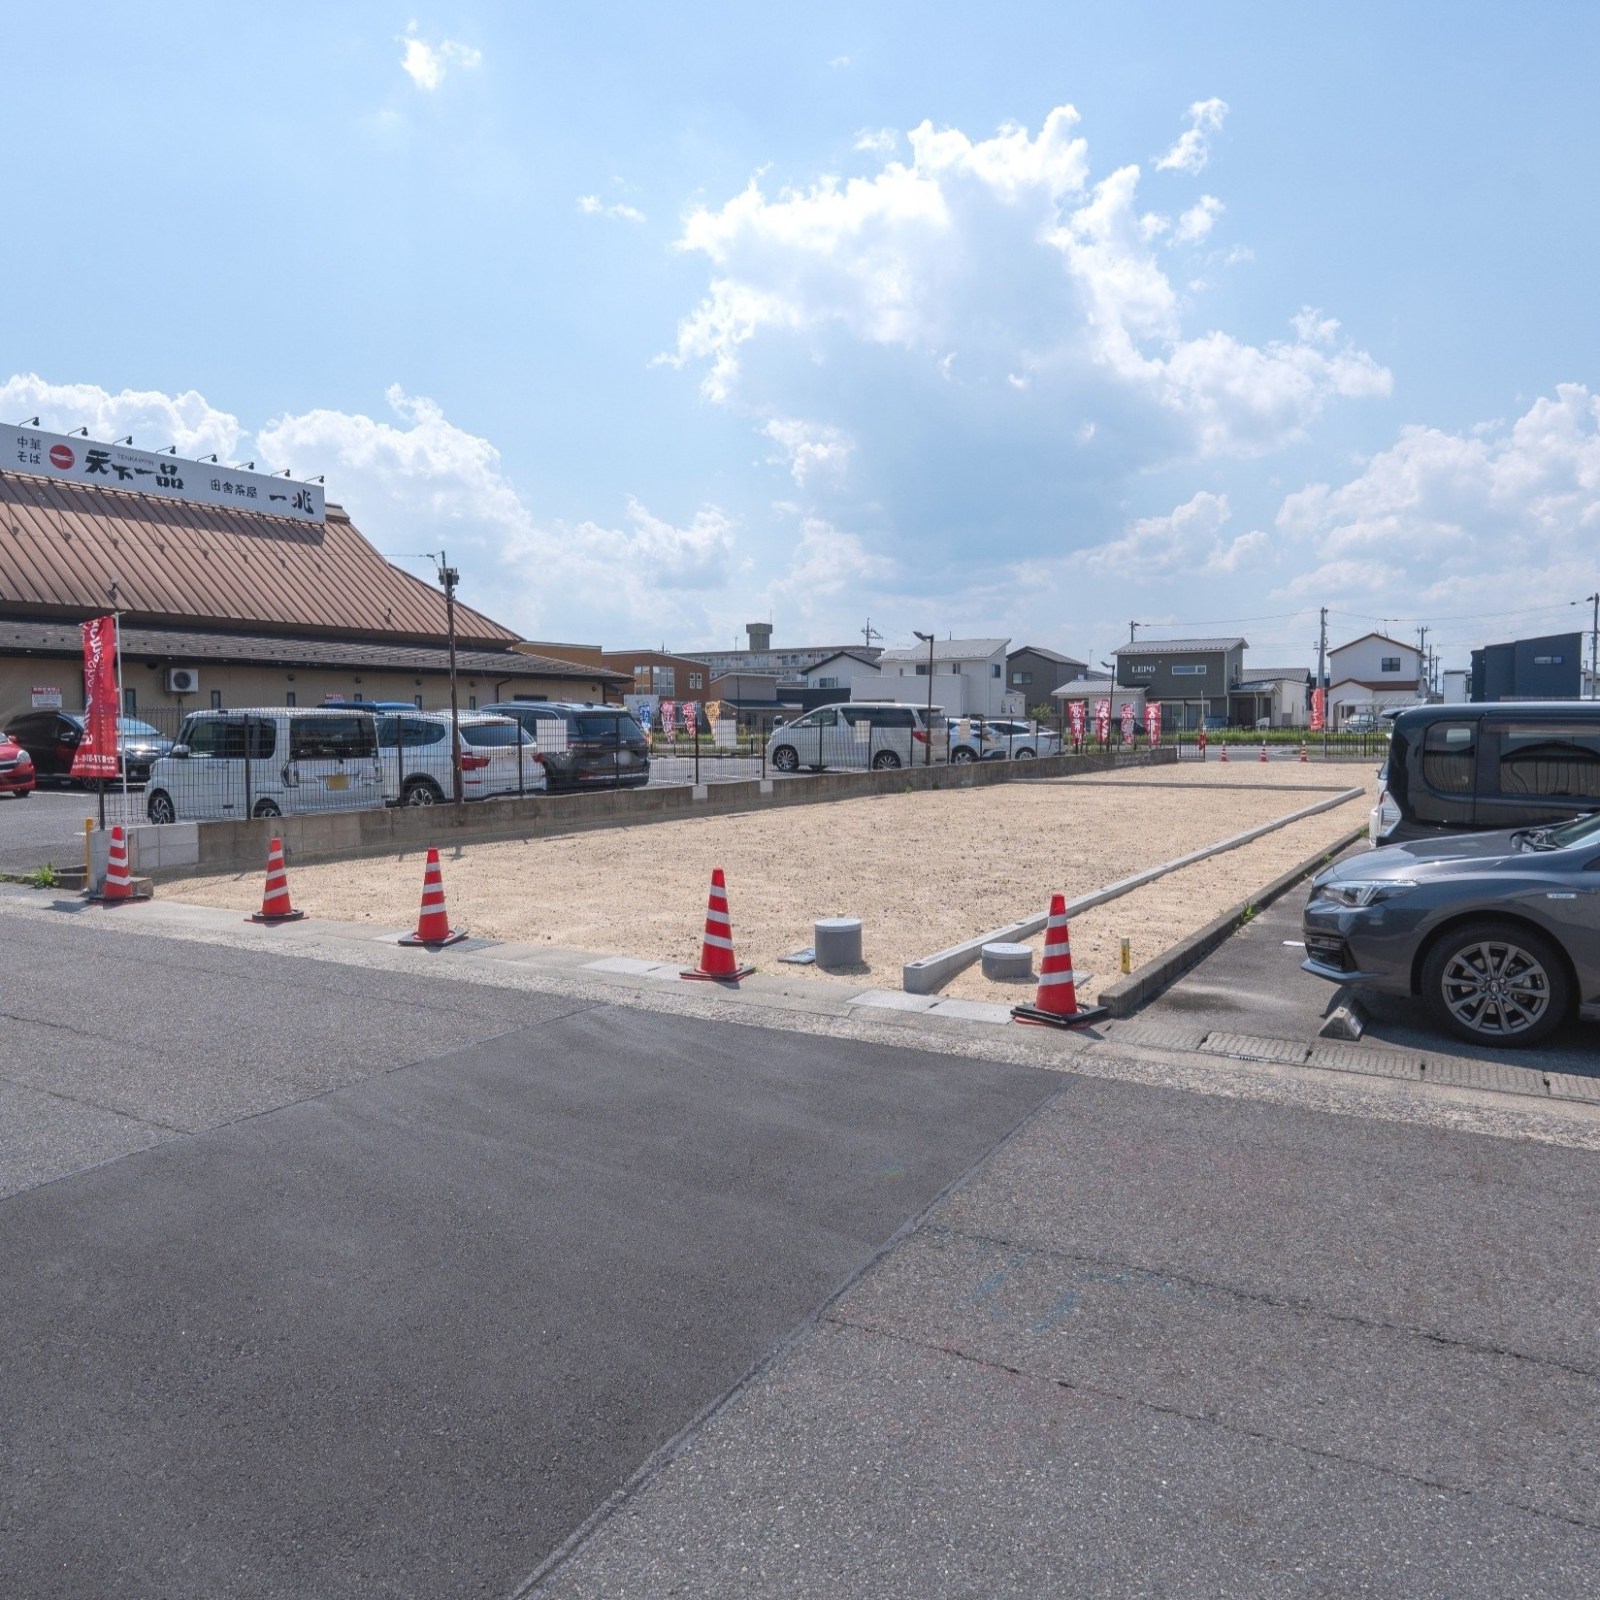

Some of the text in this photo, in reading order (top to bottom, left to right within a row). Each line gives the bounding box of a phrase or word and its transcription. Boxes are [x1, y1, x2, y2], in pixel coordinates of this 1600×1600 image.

[17, 436, 42, 451] 中華
[17, 450, 42, 465] そば
[84, 449, 185, 490] 天下一品
[210, 479, 257, 499] 田舎茶屋
